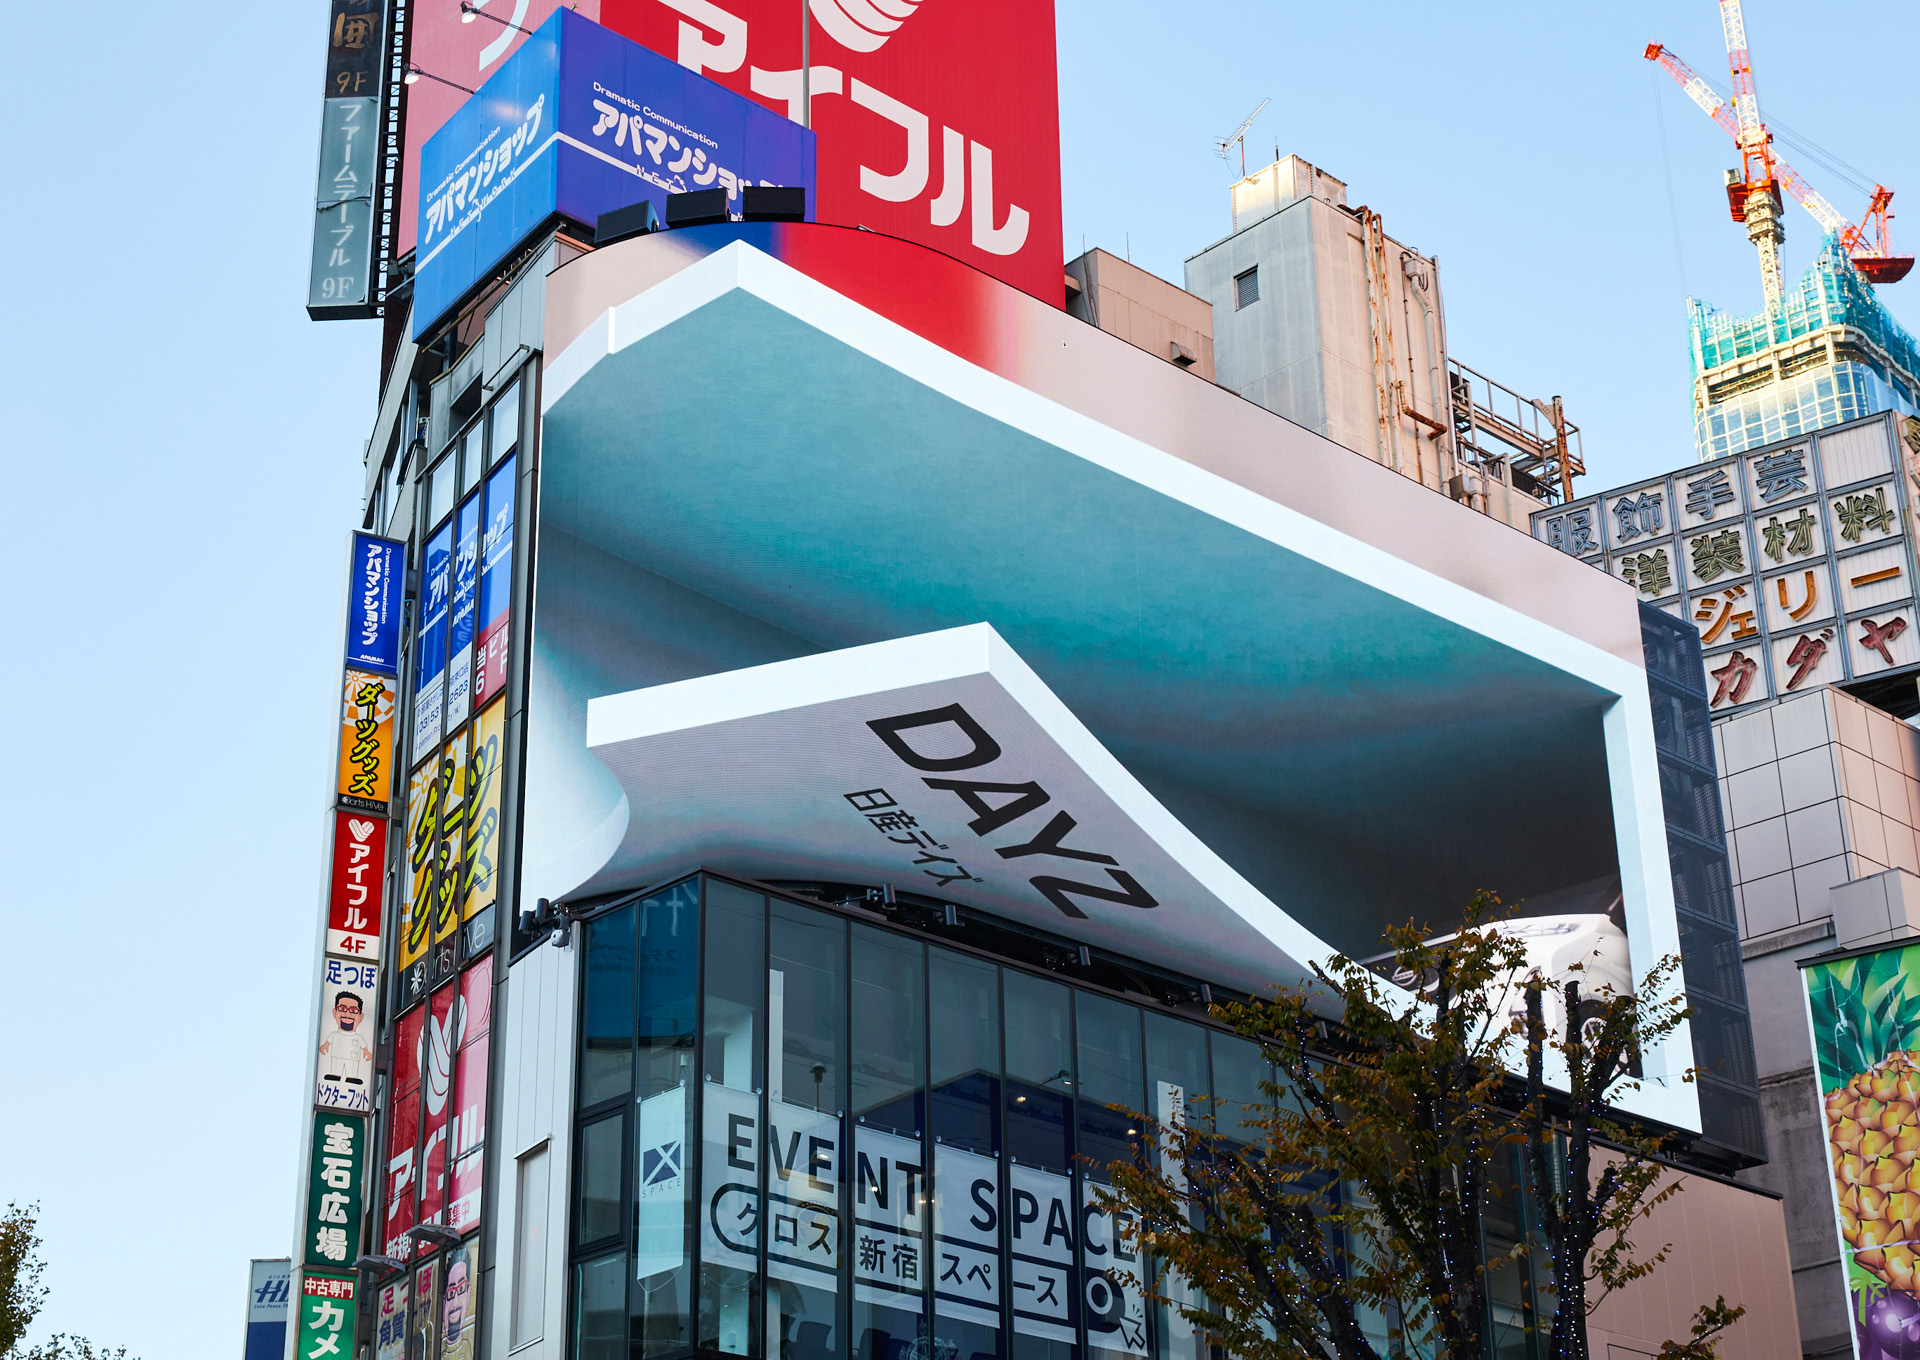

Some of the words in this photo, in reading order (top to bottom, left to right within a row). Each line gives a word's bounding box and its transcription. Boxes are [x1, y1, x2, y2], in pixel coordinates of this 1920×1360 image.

[336, 71, 368, 94] 9F
[593, 81, 641, 112] Dramatic
[642, 106, 719, 150] Communication
[424, 93, 545, 244] アパマンショップ
[427, 172, 454, 202] Dramatic
[454, 126, 501, 174] Communication
[592, 98, 784, 201] アパマンショ
[321, 276, 354, 299] 9F
[1546, 448, 1808, 558] 服飾手芸
[1620, 486, 1896, 595] 洋装材料
[361, 543, 383, 646] アパマンショップ
[384, 547, 392, 576] Dramatic
[381, 577, 390, 624] Communication
[1710, 616, 1908, 708] カダヤ
[349, 683, 385, 796] ダーツグッズ
[843, 788, 984, 887] 日産デイズ
[344, 842, 371, 930] アイフル
[326, 960, 377, 989] 足つぼ
[340, 935, 367, 954] 4F
[317, 1082, 369, 1110] ドクターフット
[315, 1122, 355, 1262] 宝石広場
[642, 1177, 682, 1199] SPACE
[727, 1112, 922, 1216] EVENT
[969, 1178, 1136, 1264] SPACE
[304, 1277, 354, 1299] 中古専門
[307, 1300, 345, 1360] カメ
